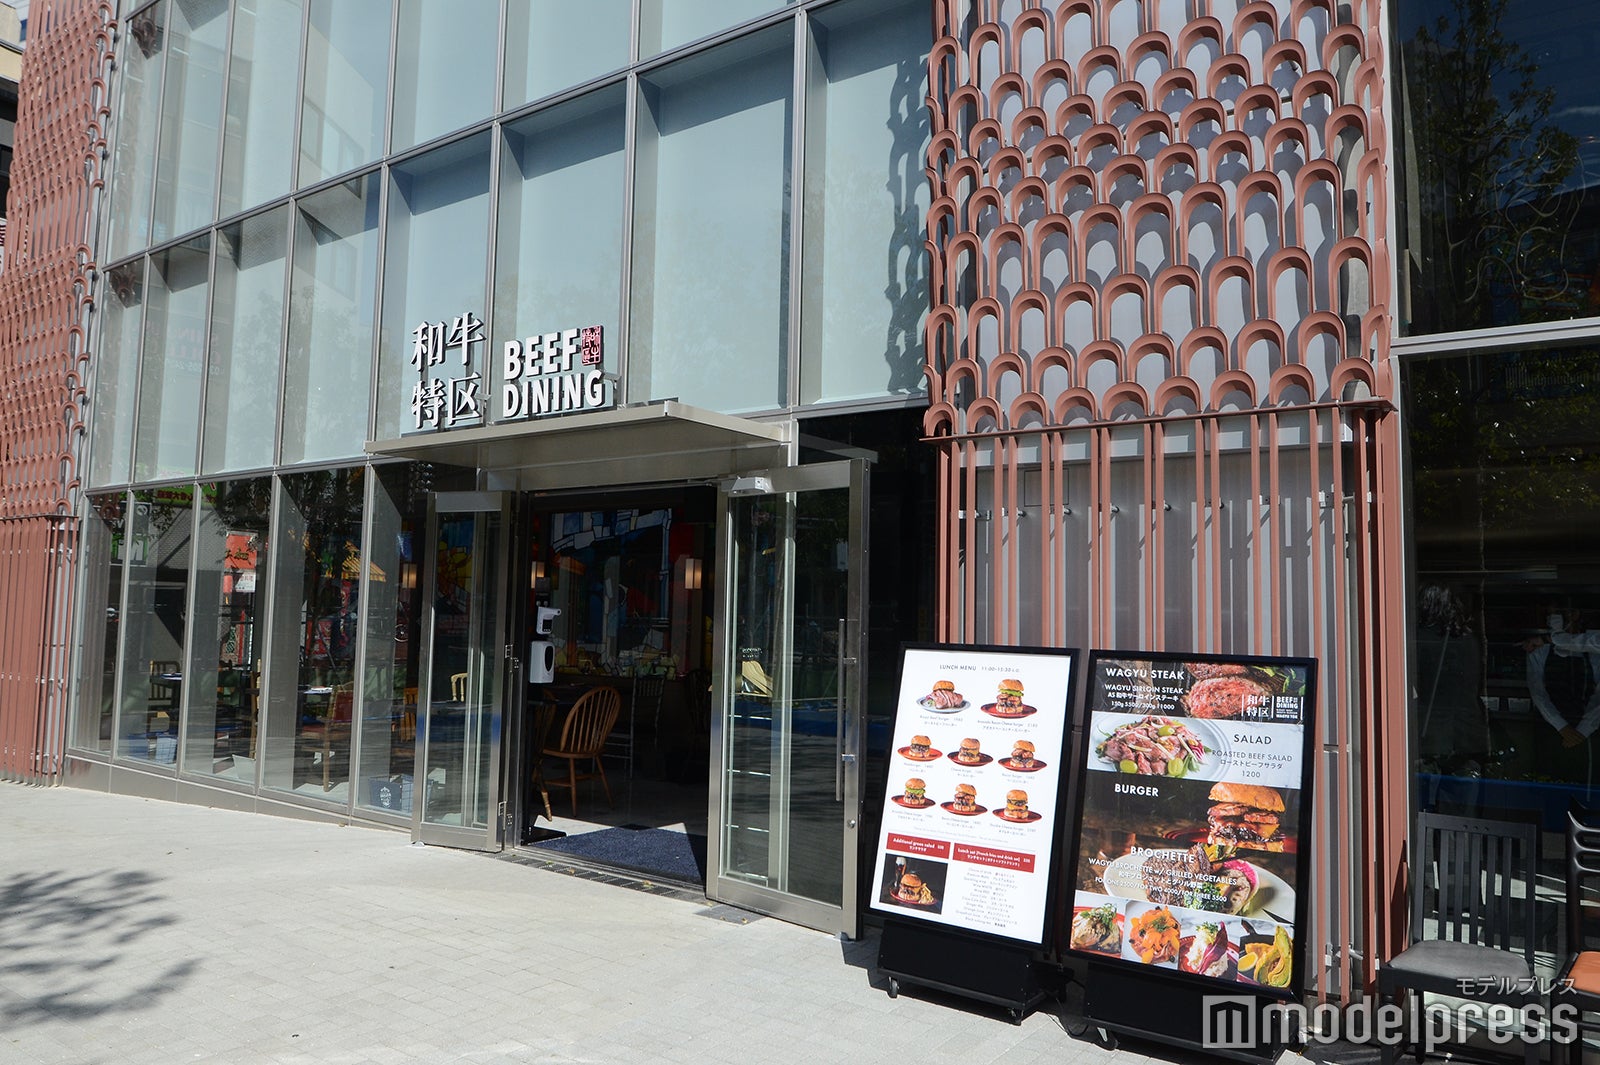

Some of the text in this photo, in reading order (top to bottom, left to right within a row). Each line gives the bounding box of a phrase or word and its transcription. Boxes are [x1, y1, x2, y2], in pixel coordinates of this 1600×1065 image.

[410, 312, 486, 371] 和牛
[504, 328, 580, 380] BEEF
[502, 370, 605, 418] DINING
[412, 372, 482, 429] 特区
[1106, 668, 1184, 680] WAGYU STEAK
[1132, 685, 1160, 693] SIRLOIN
[1248, 695, 1270, 706] 和牛
[1247, 706, 1268, 717] 特区
[1234, 734, 1272, 744] SALAD
[1212, 750, 1246, 758] ROASTED
[1268, 754, 1292, 762] SALAD
[1220, 760, 1282, 769] ローストビーフサラダ
[1242, 770, 1260, 778] 1200
[1114, 784, 1159, 797] BURGER
[1131, 846, 1194, 864] BROCHETTE
[1089, 858, 1114, 868] WAGYU
[1116, 861, 1152, 873] BROCHETTE
[1166, 870, 1193, 879] GRILLED
[1194, 873, 1237, 885] VEGETABLES
